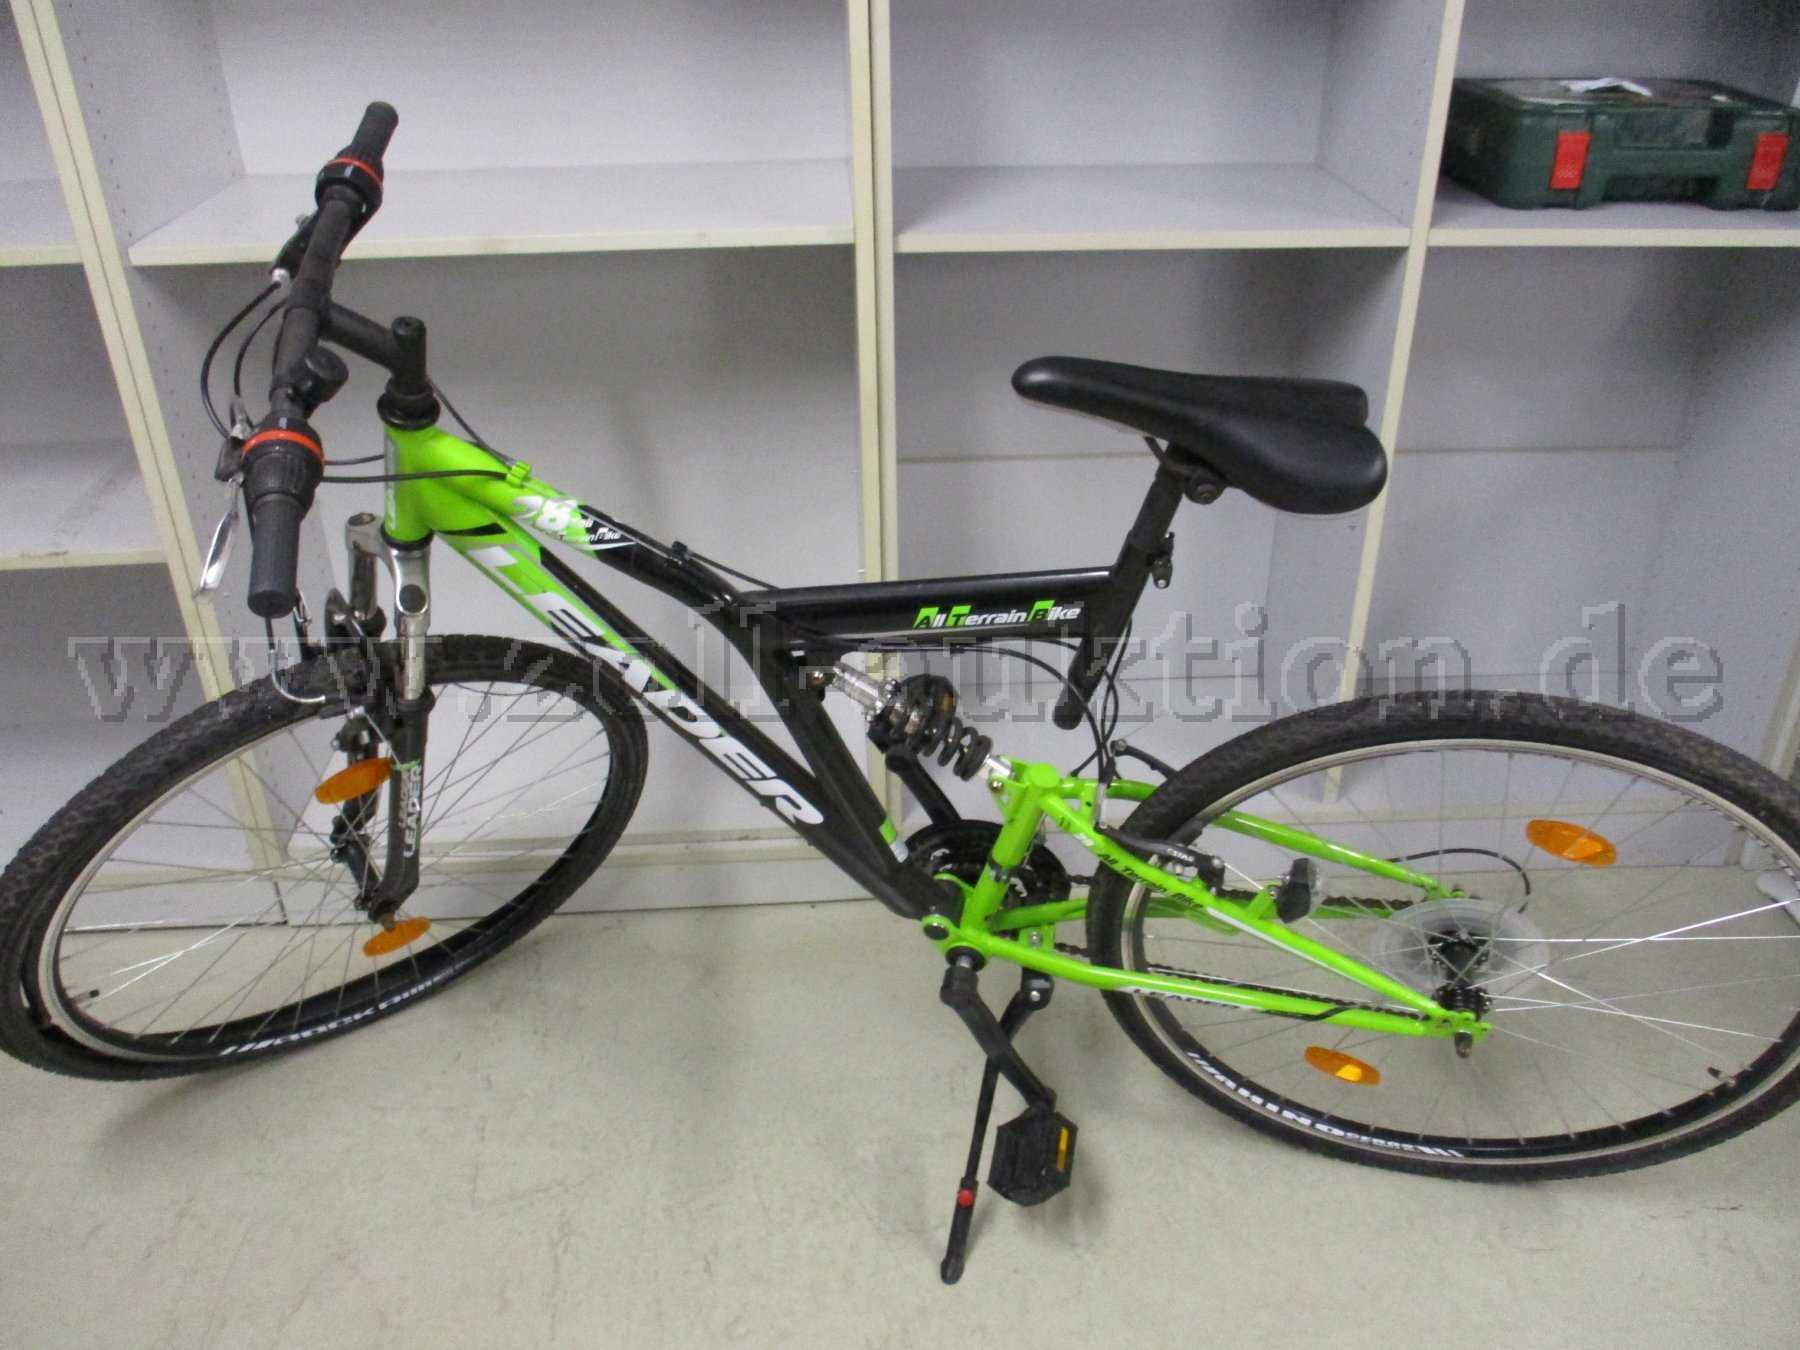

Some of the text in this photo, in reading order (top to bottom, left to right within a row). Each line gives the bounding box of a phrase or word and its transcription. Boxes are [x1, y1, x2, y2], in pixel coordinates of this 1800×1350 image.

[467, 545, 824, 825] LEADER
[913, 600, 1081, 629] All Terrain Bike
